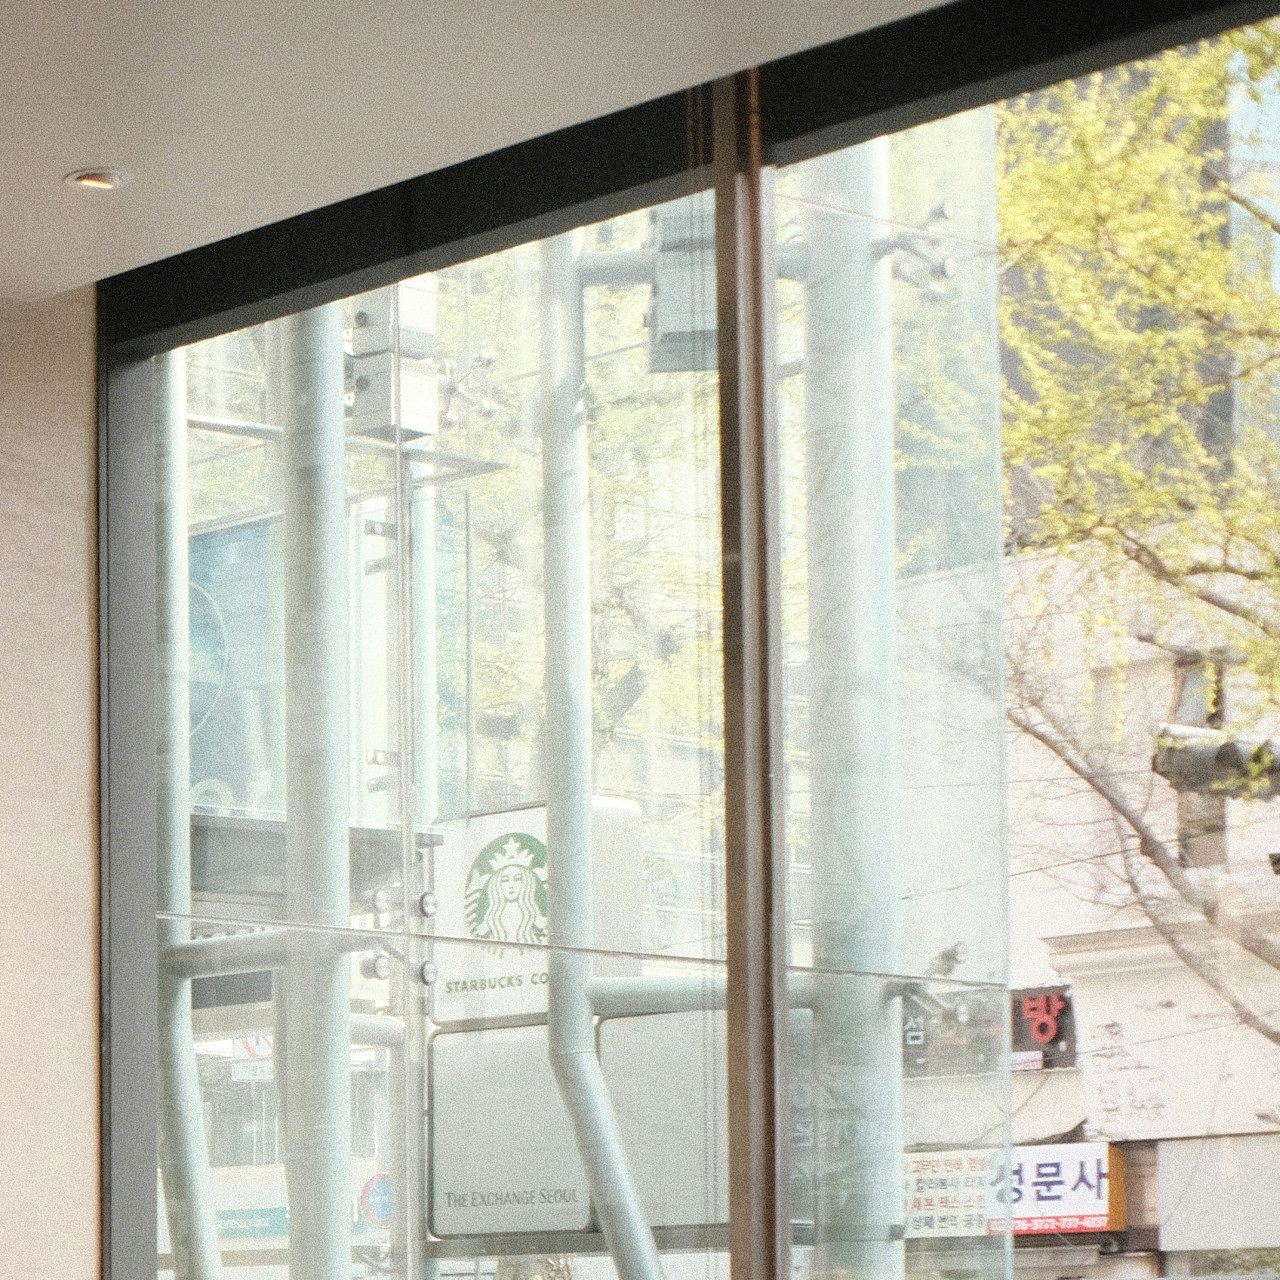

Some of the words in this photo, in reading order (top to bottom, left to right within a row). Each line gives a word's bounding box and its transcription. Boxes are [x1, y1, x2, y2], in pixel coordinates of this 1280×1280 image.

[445, 974, 523, 993] STARBUCKS
[445, 1192, 468, 1207] THE
[471, 1190, 535, 1207] EXCHANGE
[539, 1188, 578, 1205] SEOUL
